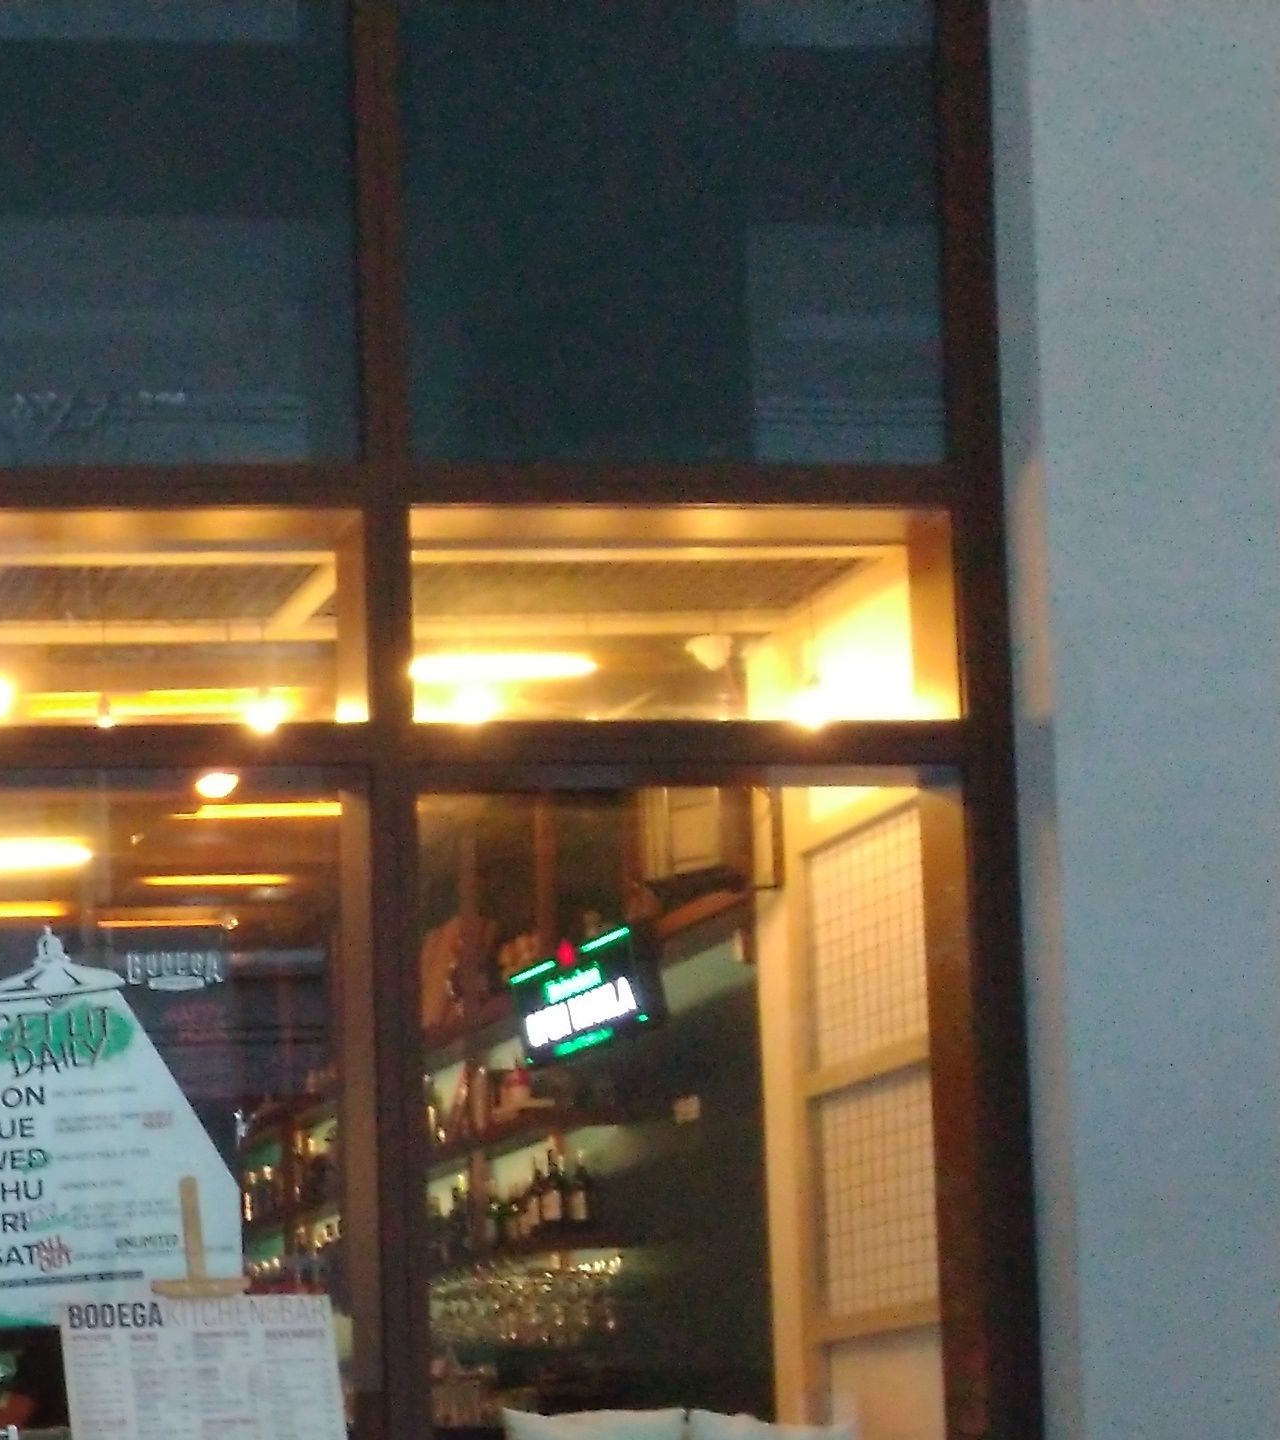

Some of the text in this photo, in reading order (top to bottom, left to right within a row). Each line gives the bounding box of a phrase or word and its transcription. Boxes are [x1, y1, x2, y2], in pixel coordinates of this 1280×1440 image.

[66, 1006, 110, 1042] LIT
[6, 1035, 109, 1078] DAILY
[68, 1301, 165, 1330] BODEGA
